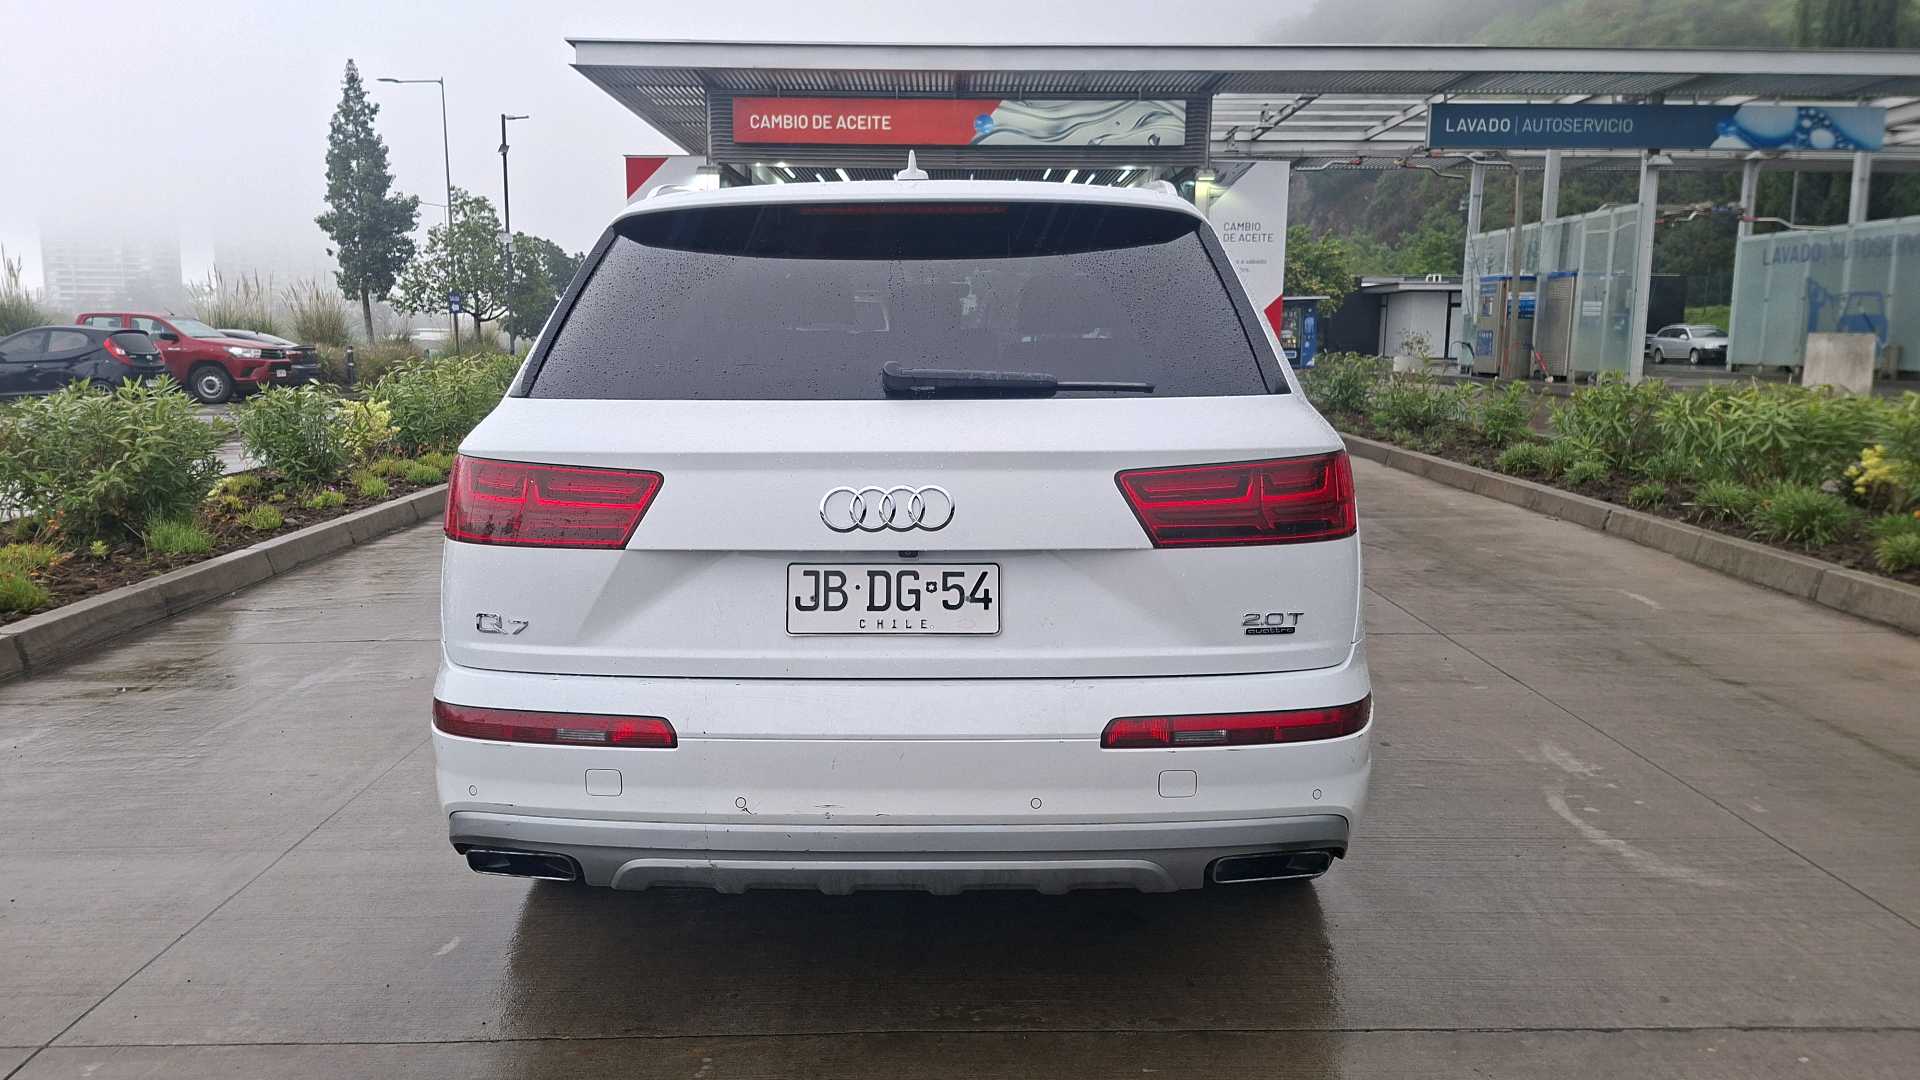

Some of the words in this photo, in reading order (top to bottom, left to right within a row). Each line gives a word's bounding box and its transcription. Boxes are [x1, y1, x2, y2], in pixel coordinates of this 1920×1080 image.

[750, 114, 808, 129] CAMBIO
[812, 115, 832, 129] DE
[836, 115, 891, 130] ACEITE
[1445, 118, 1511, 133] LAVADO
[1522, 118, 1634, 133] AUTOSERVICIO
[1223, 222, 1261, 232] CAMBIO
[1223, 233, 1236, 242] DE
[1239, 233, 1274, 242] ACEITE
[1762, 242, 1823, 266] LAVADO
[476, 613, 529, 635] Q7
[1243, 612, 1304, 626] 2.0T
[1246, 627, 1295, 635] quattro
